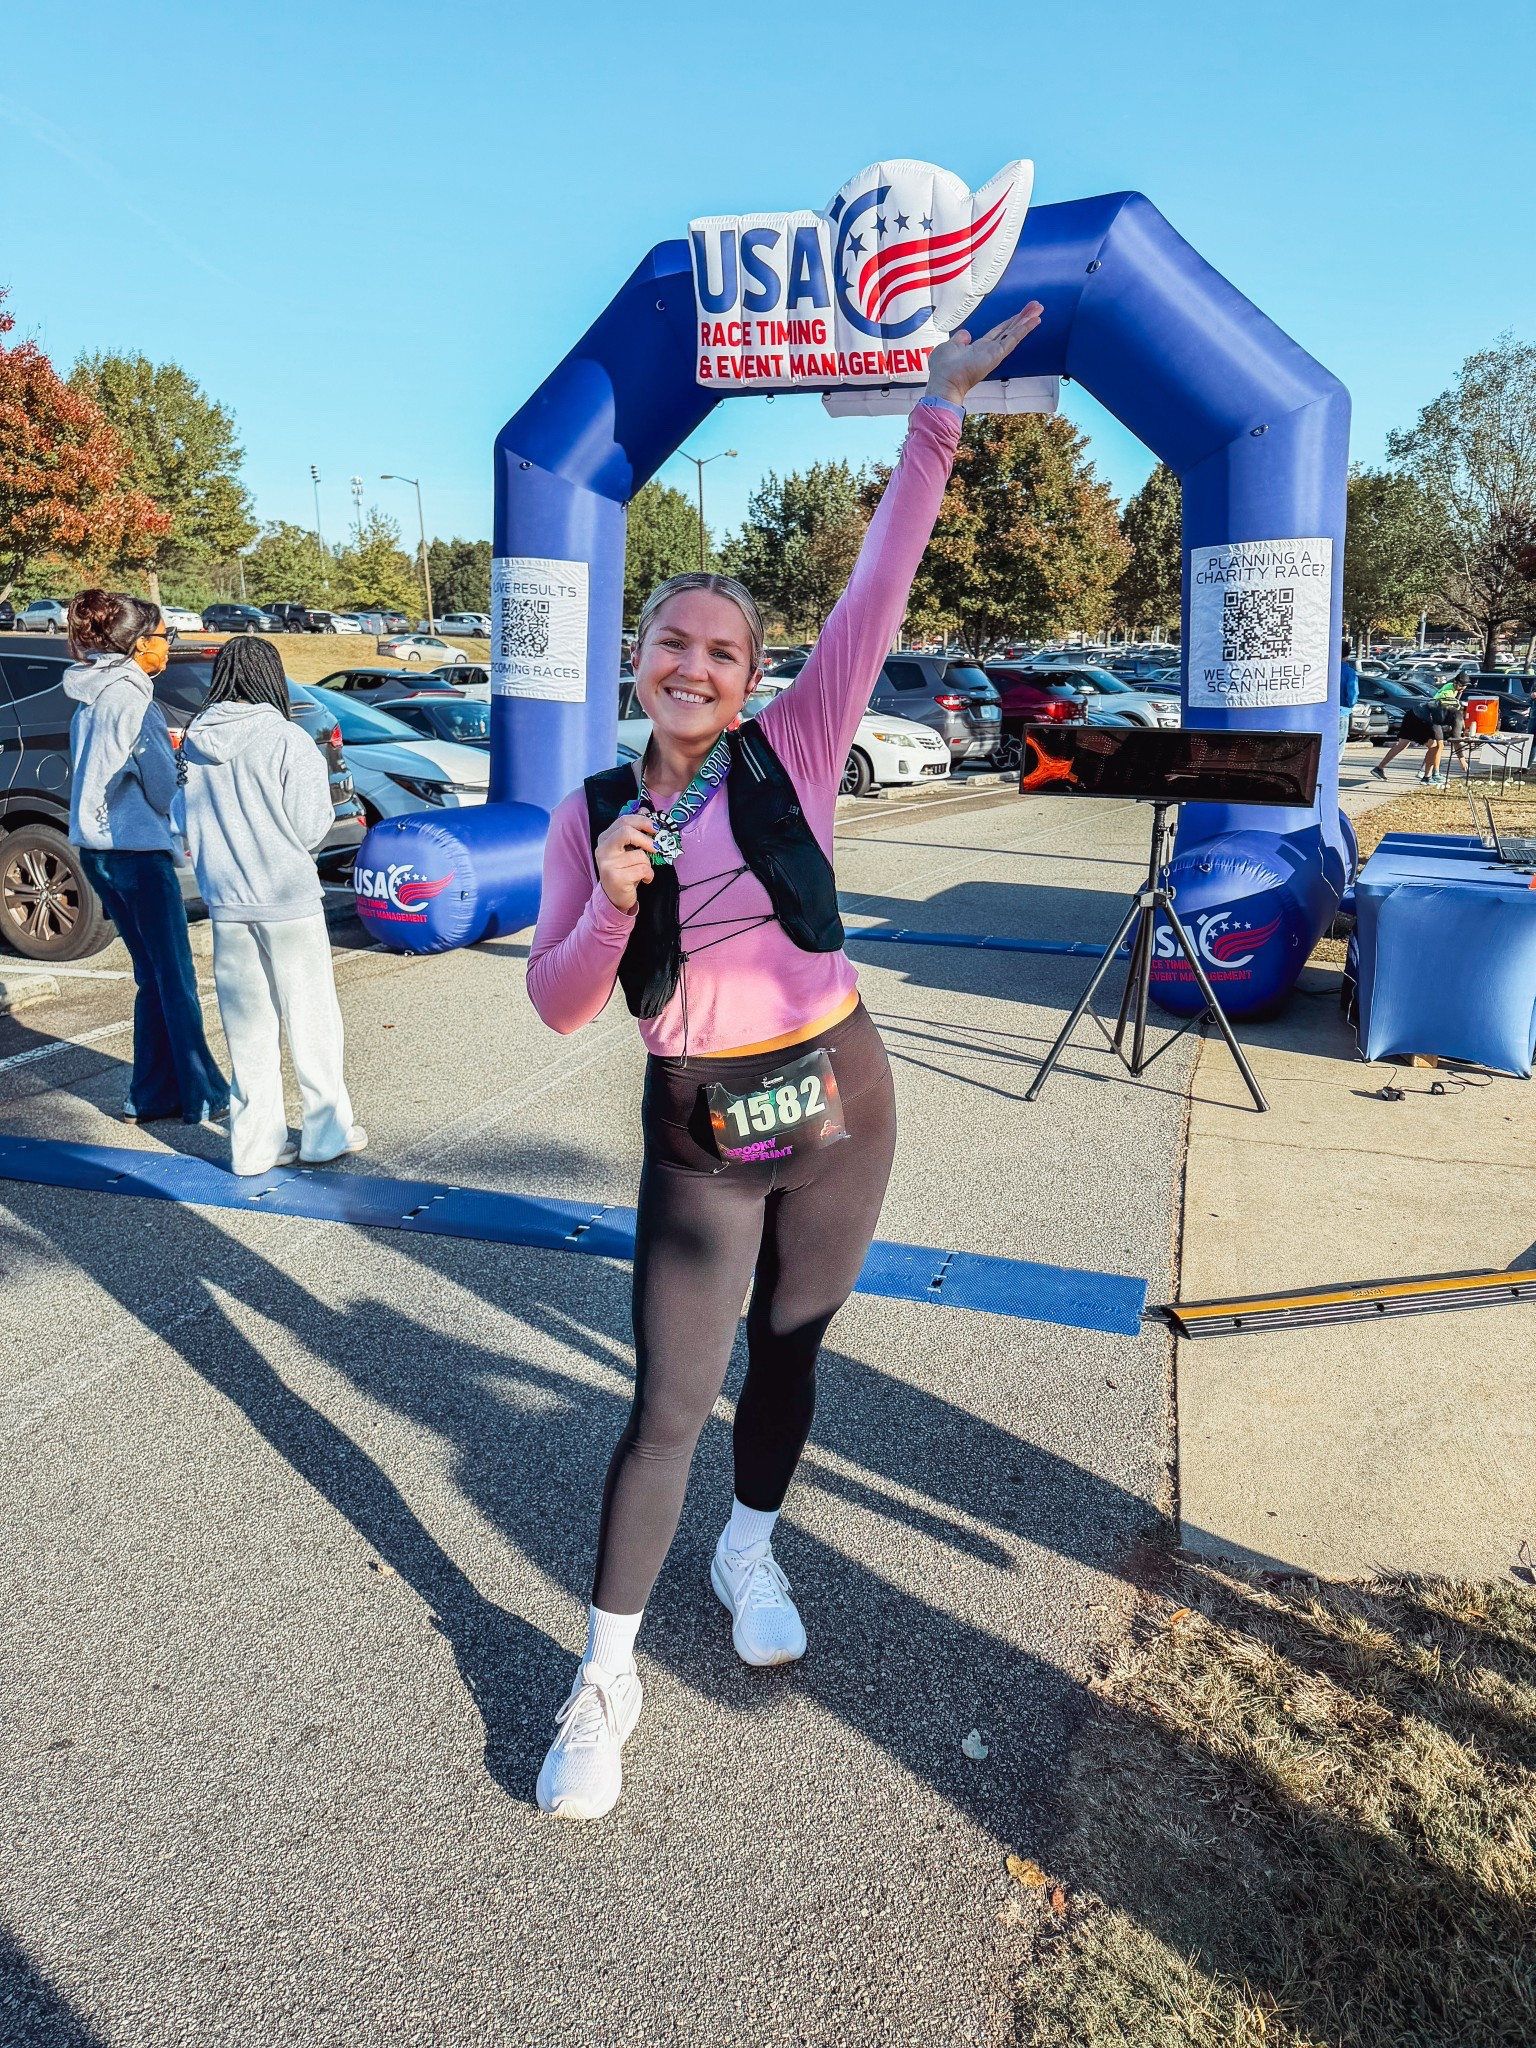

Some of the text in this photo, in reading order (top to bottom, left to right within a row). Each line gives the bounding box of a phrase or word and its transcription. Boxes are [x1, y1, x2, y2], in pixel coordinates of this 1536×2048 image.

[692, 226, 831, 313] USA
[701, 318, 827, 347] RACE TIMING
[699, 345, 935, 380] & EVENT MANAGEMENT
[1209, 551, 1312, 571] PLANNING A
[1196, 563, 1325, 585] CHARITY RACE?
[513, 582, 577, 598] RESULTS
[491, 662, 580, 679] PCOMING RACES
[1204, 664, 1312, 681] WE CAN HELP
[1207, 676, 1305, 693] SCAN HERE!
[669, 781, 708, 823] OKY
[354, 866, 389, 899] USA
[376, 911, 428, 923] MANAGEMENT
[1152, 925, 1200, 958] SA
[1152, 959, 1191, 970] CE TIMIN
[726, 1075, 826, 1137] 1582
[726, 1137, 776, 1158] SPOOKY
[741, 1145, 794, 1163] SPRINT
